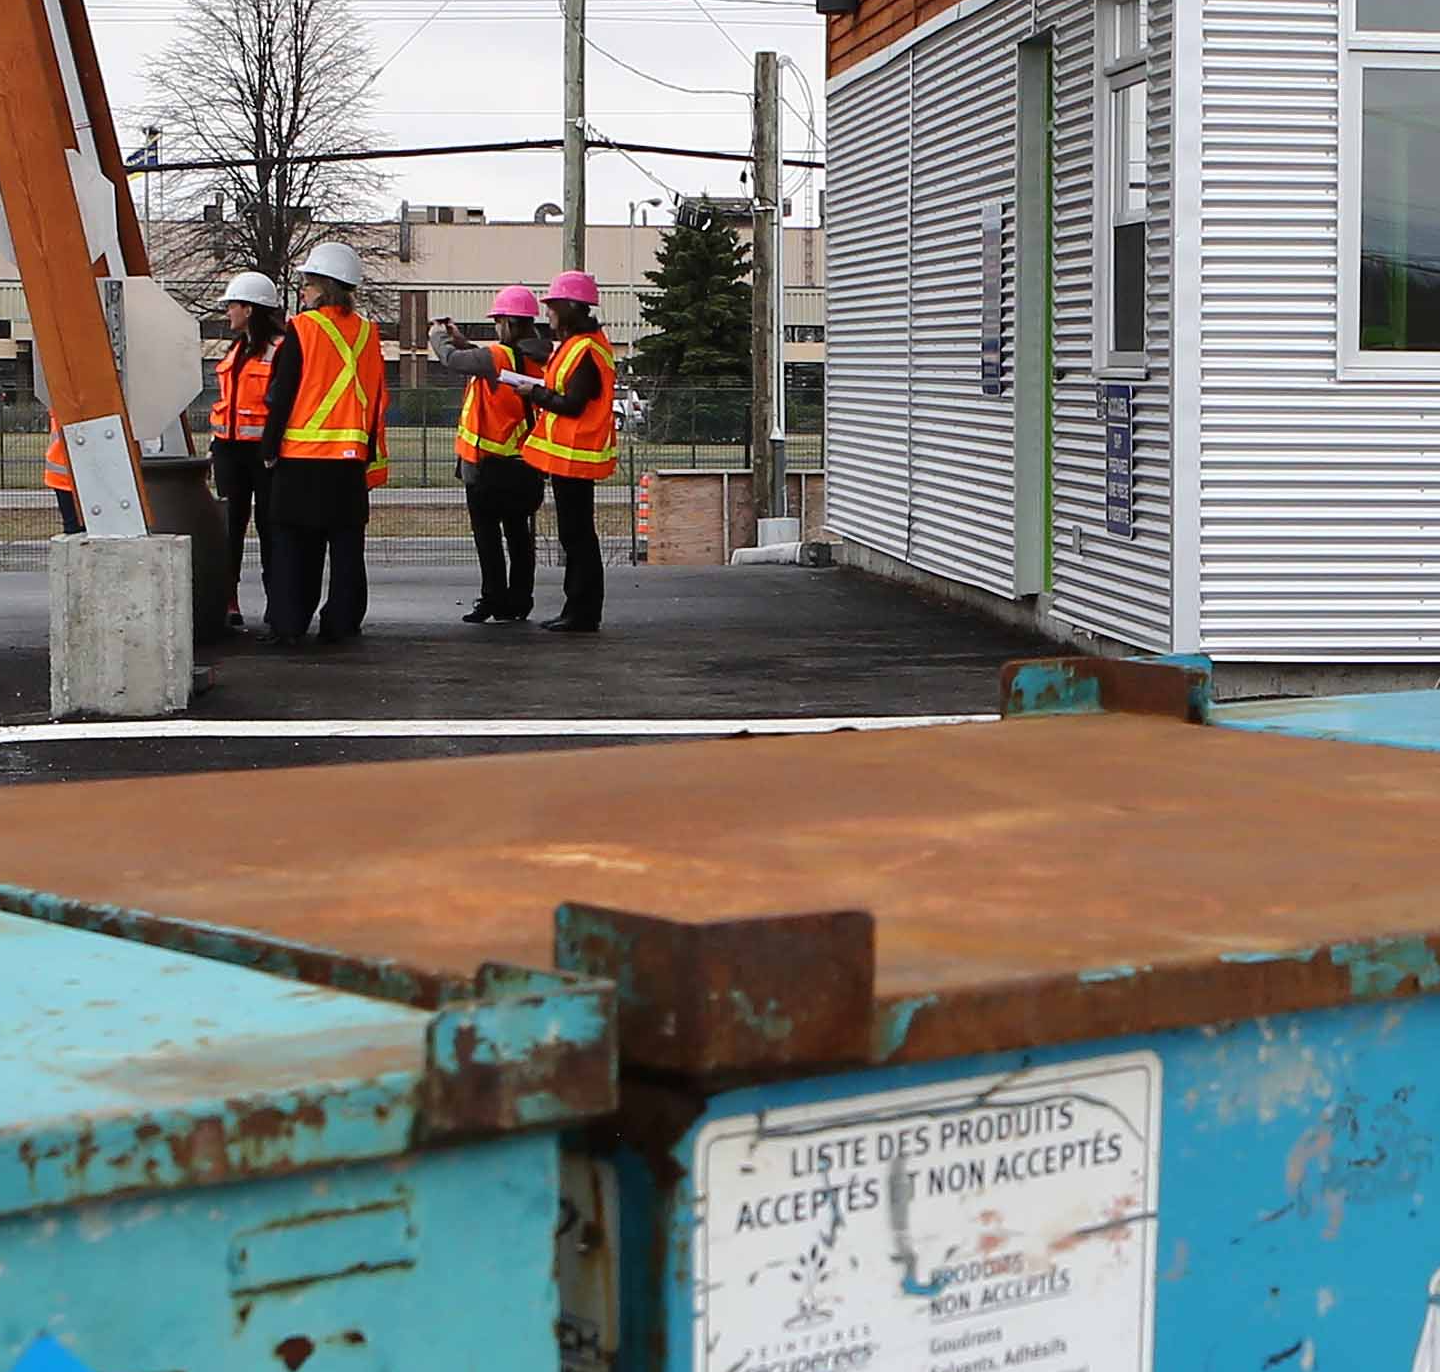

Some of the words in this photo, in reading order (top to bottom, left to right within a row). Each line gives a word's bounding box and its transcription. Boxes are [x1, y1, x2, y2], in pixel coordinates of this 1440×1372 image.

[791, 1136, 867, 1178] LISTE
[879, 1126, 929, 1161] DES
[940, 1100, 1074, 1147] PRODUITS
[736, 1173, 879, 1233] ACCEPTÉS
[928, 1161, 986, 1196] NON
[992, 1129, 1122, 1183] ACCEPTÉS
[930, 1291, 970, 1315] NON
[981, 1266, 1071, 1305] ACCEPTÉS
[930, 1327, 1002, 1354] Goudrons
[1004, 1337, 1067, 1365] Adhésifs
